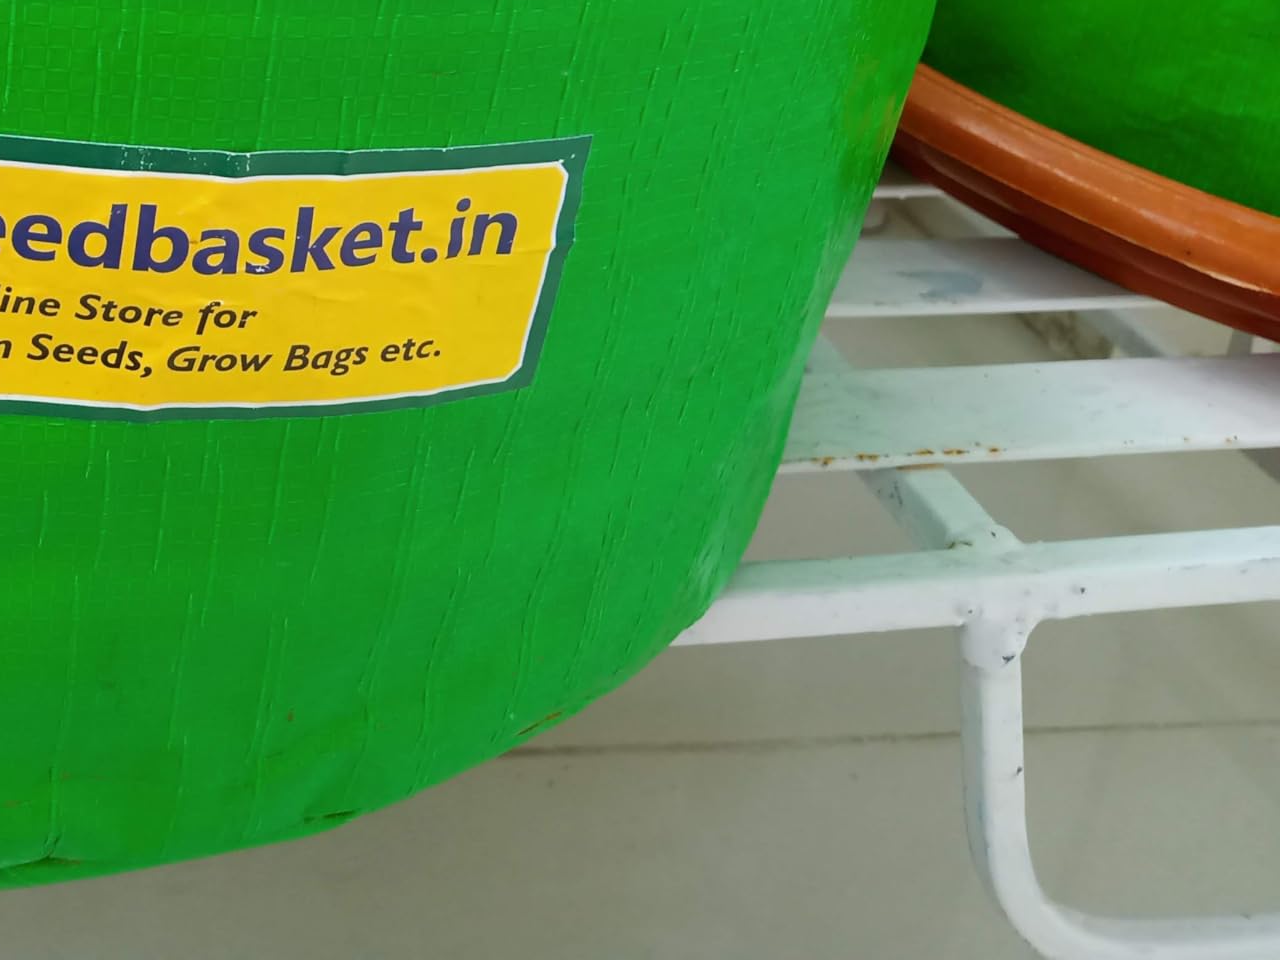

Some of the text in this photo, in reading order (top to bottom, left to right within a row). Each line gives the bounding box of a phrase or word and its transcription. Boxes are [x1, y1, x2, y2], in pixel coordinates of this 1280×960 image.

[74, 294, 184, 328] Store
[195, 301, 258, 336] for
[26, 333, 153, 378] Seeds,
[166, 345, 273, 373] Grow
[283, 344, 369, 376] Bags
[379, 338, 442, 364] etc.
